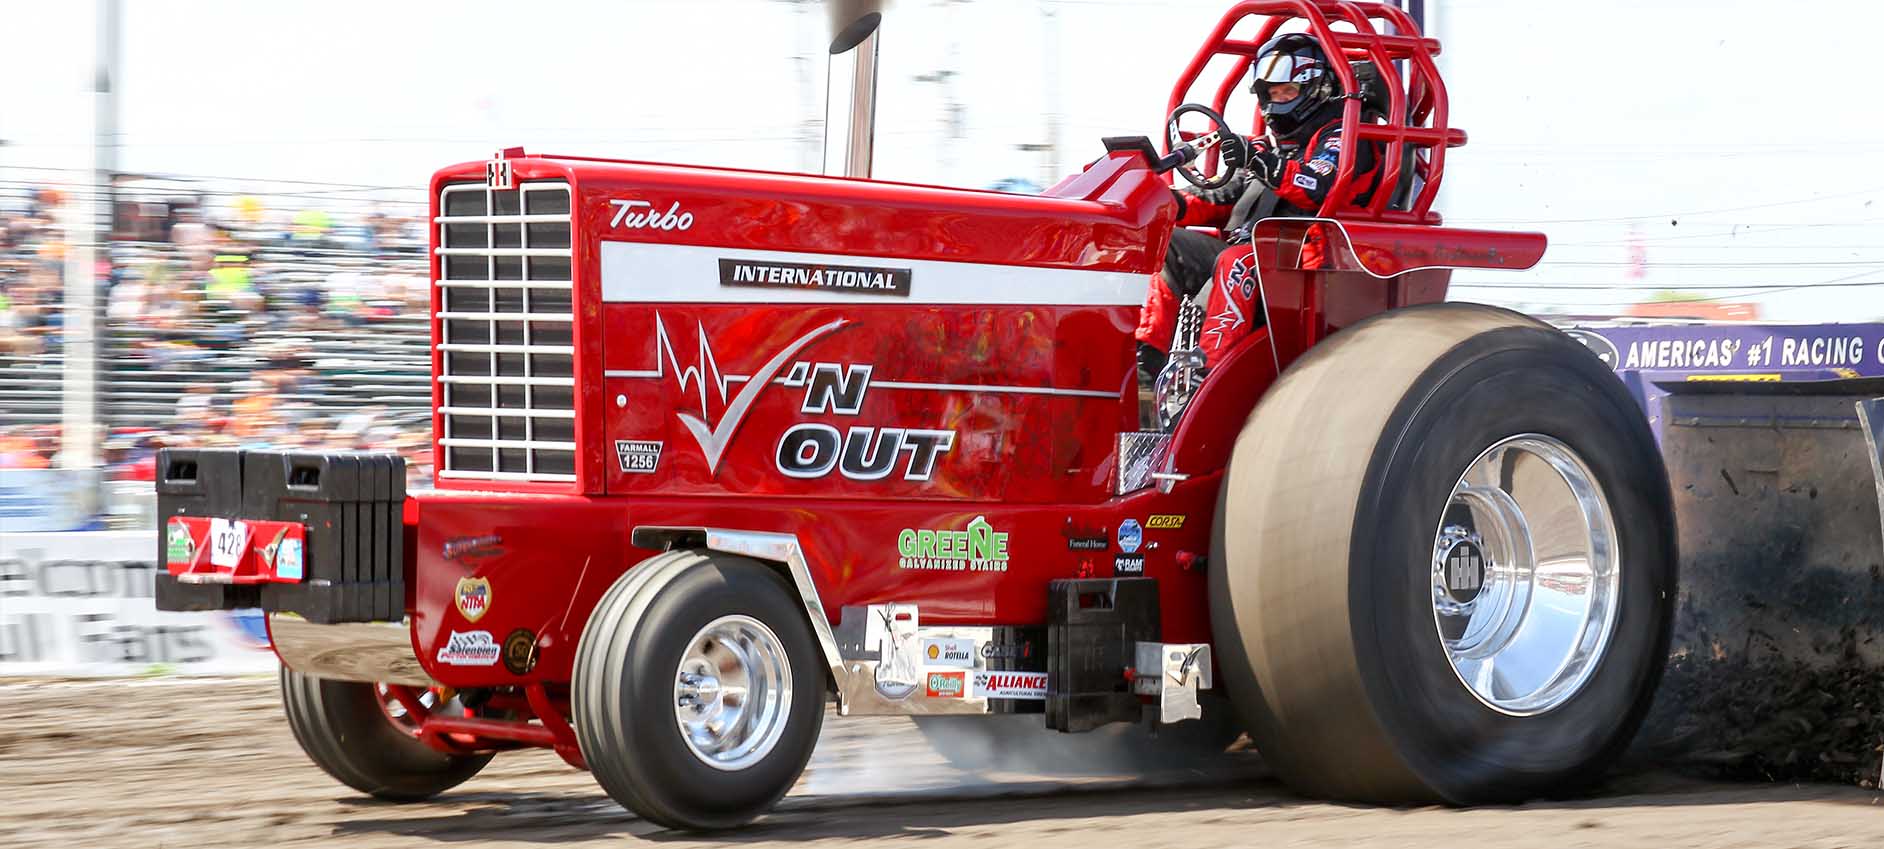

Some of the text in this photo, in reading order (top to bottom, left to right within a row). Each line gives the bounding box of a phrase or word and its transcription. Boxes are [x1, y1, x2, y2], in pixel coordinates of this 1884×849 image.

[609, 199, 694, 231] Turbo
[733, 264, 897, 290] INTERNATIONAL
[1625, 338, 1741, 368] AMERICAS'
[1747, 336, 1773, 366] #1
[1782, 336, 1864, 365] RACING
[784, 361, 873, 415] 'N
[620, 444, 658, 453] FARMALL
[624, 454, 653, 468] 1256
[775, 423, 957, 480] OUT
[218, 532, 242, 557] 428
[898, 515, 1009, 561] GREENE
[1069, 539, 1107, 549] Funeral Home
[899, 557, 1008, 572] GALVANIZED STAIRS
[944, 651, 969, 660] ROTELLA
[986, 674, 1047, 691] ALLIANCE
